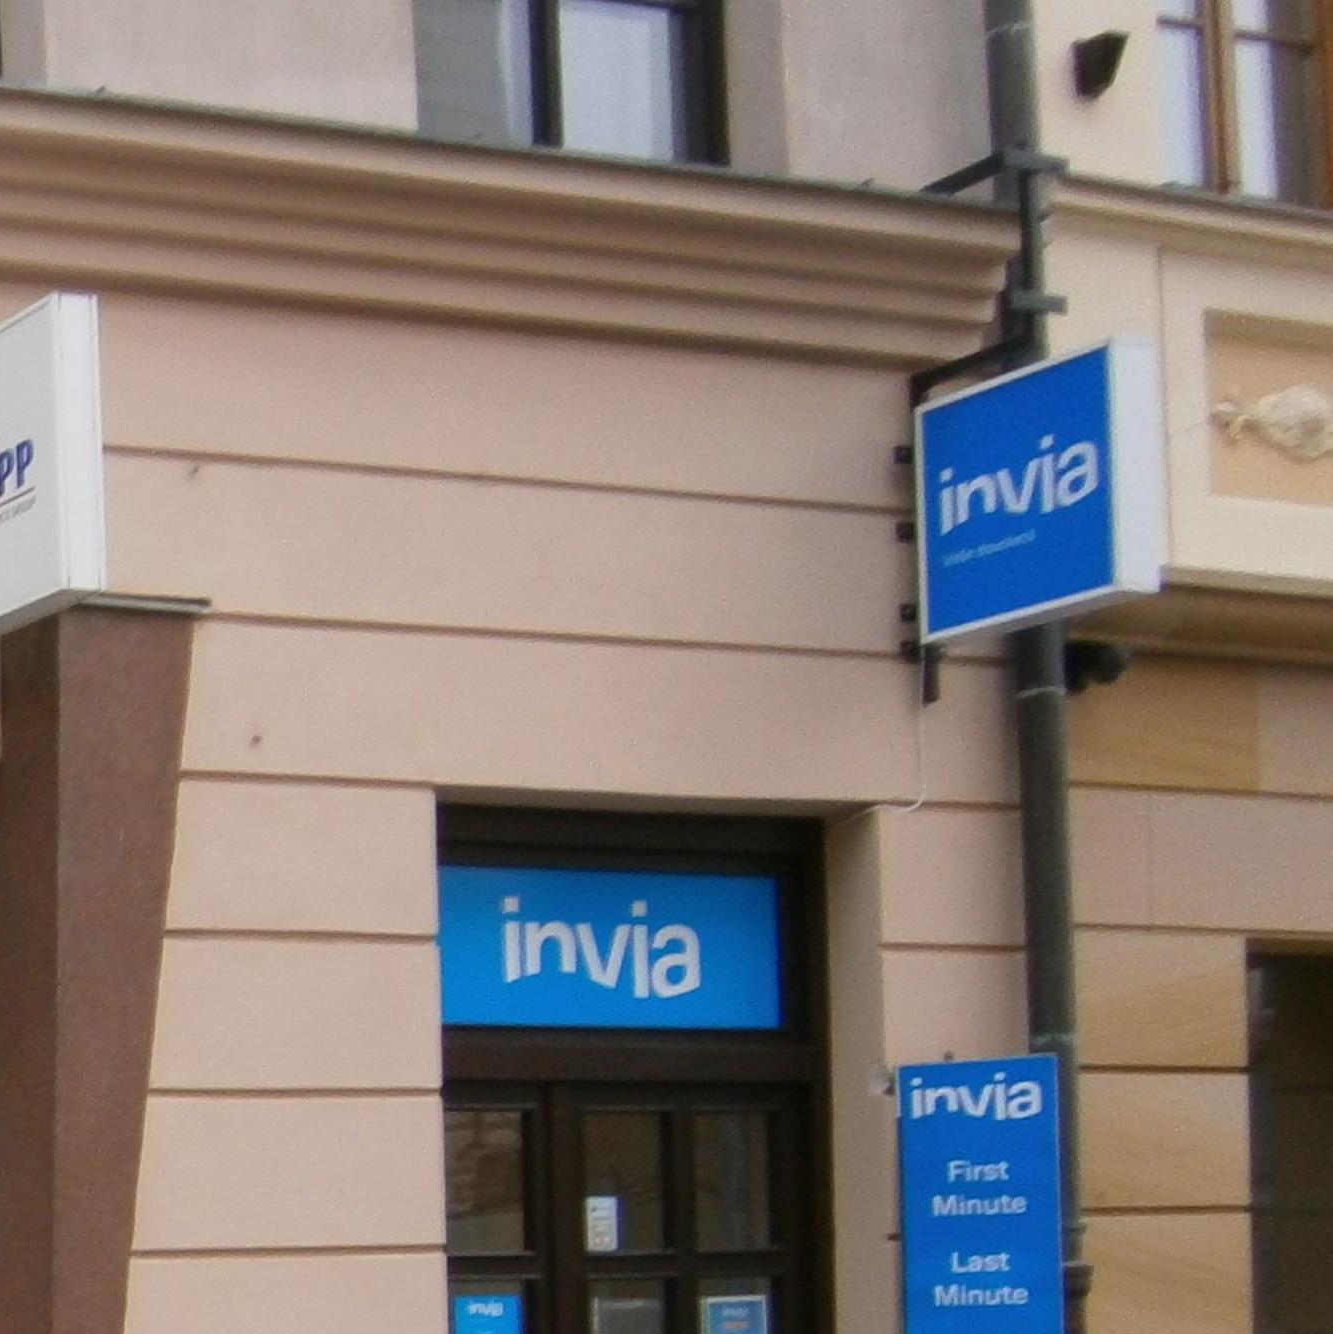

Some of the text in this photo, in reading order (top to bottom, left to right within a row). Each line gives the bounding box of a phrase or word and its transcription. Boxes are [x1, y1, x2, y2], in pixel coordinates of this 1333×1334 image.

[939, 433, 1099, 536] invia
[502, 896, 701, 1000] invia
[908, 1071, 1043, 1122] invia
[947, 1160, 1010, 1182] First
[932, 1194, 1028, 1217] Minute
[950, 1251, 1011, 1274] Last
[934, 1283, 1030, 1307] Minute
